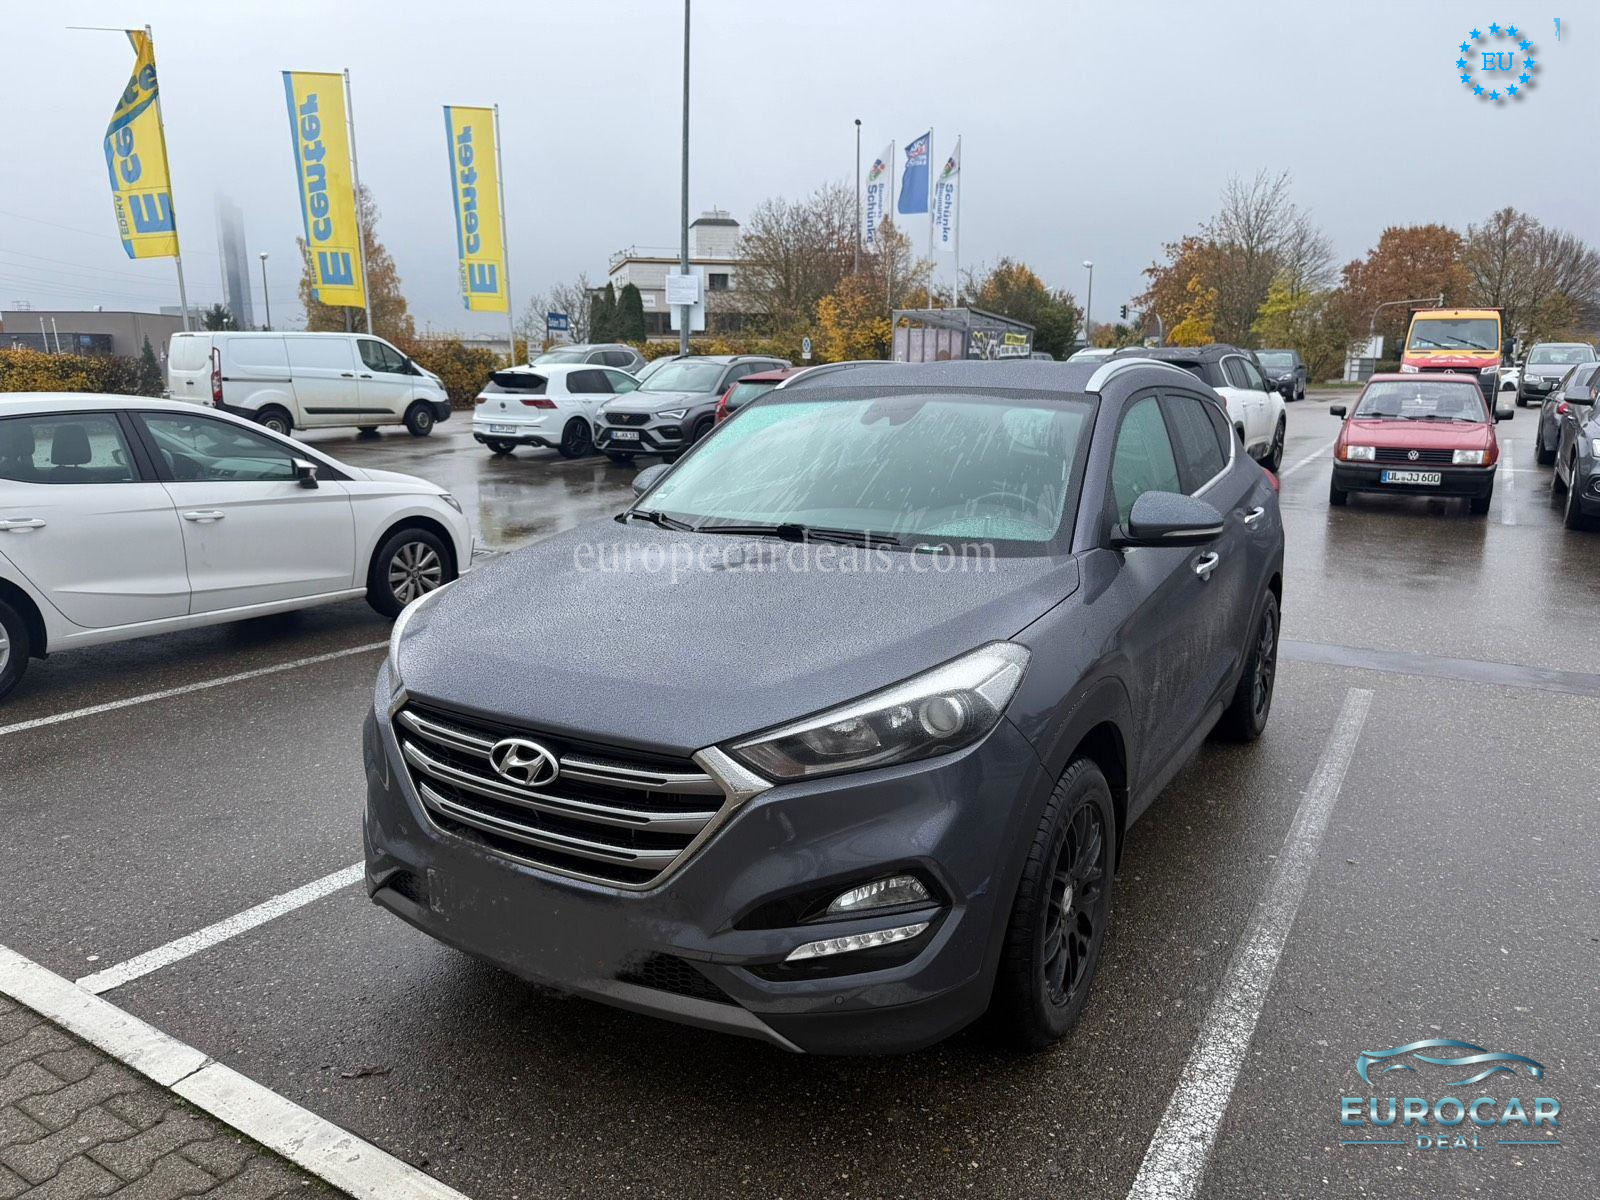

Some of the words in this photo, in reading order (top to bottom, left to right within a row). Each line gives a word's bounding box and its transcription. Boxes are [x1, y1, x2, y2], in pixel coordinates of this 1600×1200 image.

[866, 184, 878, 243] Schünke
[942, 183, 954, 242] Schünke
[1387, 472, 1399, 481] UL
